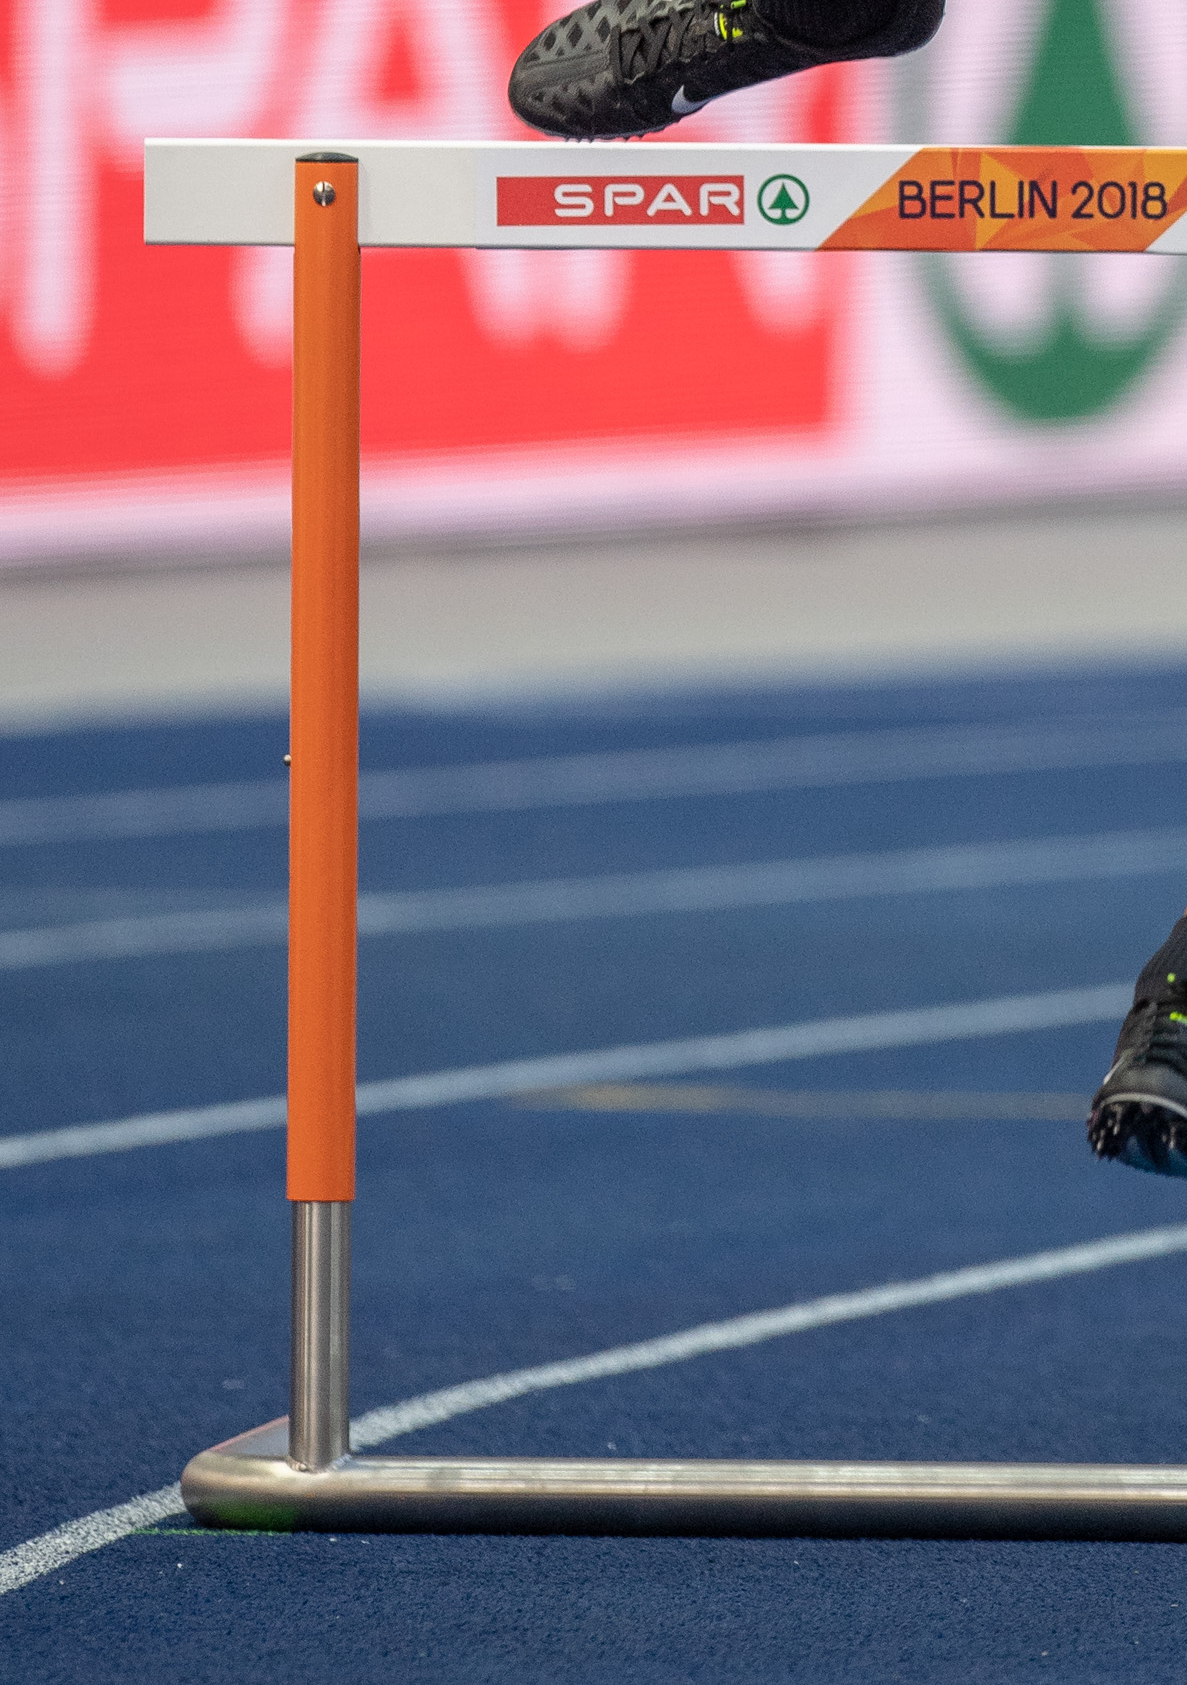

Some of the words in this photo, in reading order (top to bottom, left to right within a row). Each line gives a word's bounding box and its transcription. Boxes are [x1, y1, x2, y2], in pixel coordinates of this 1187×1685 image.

[553, 183, 742, 217] SPAR
[899, 180, 1061, 221] BERLIN
[1071, 180, 1169, 221] 2018
